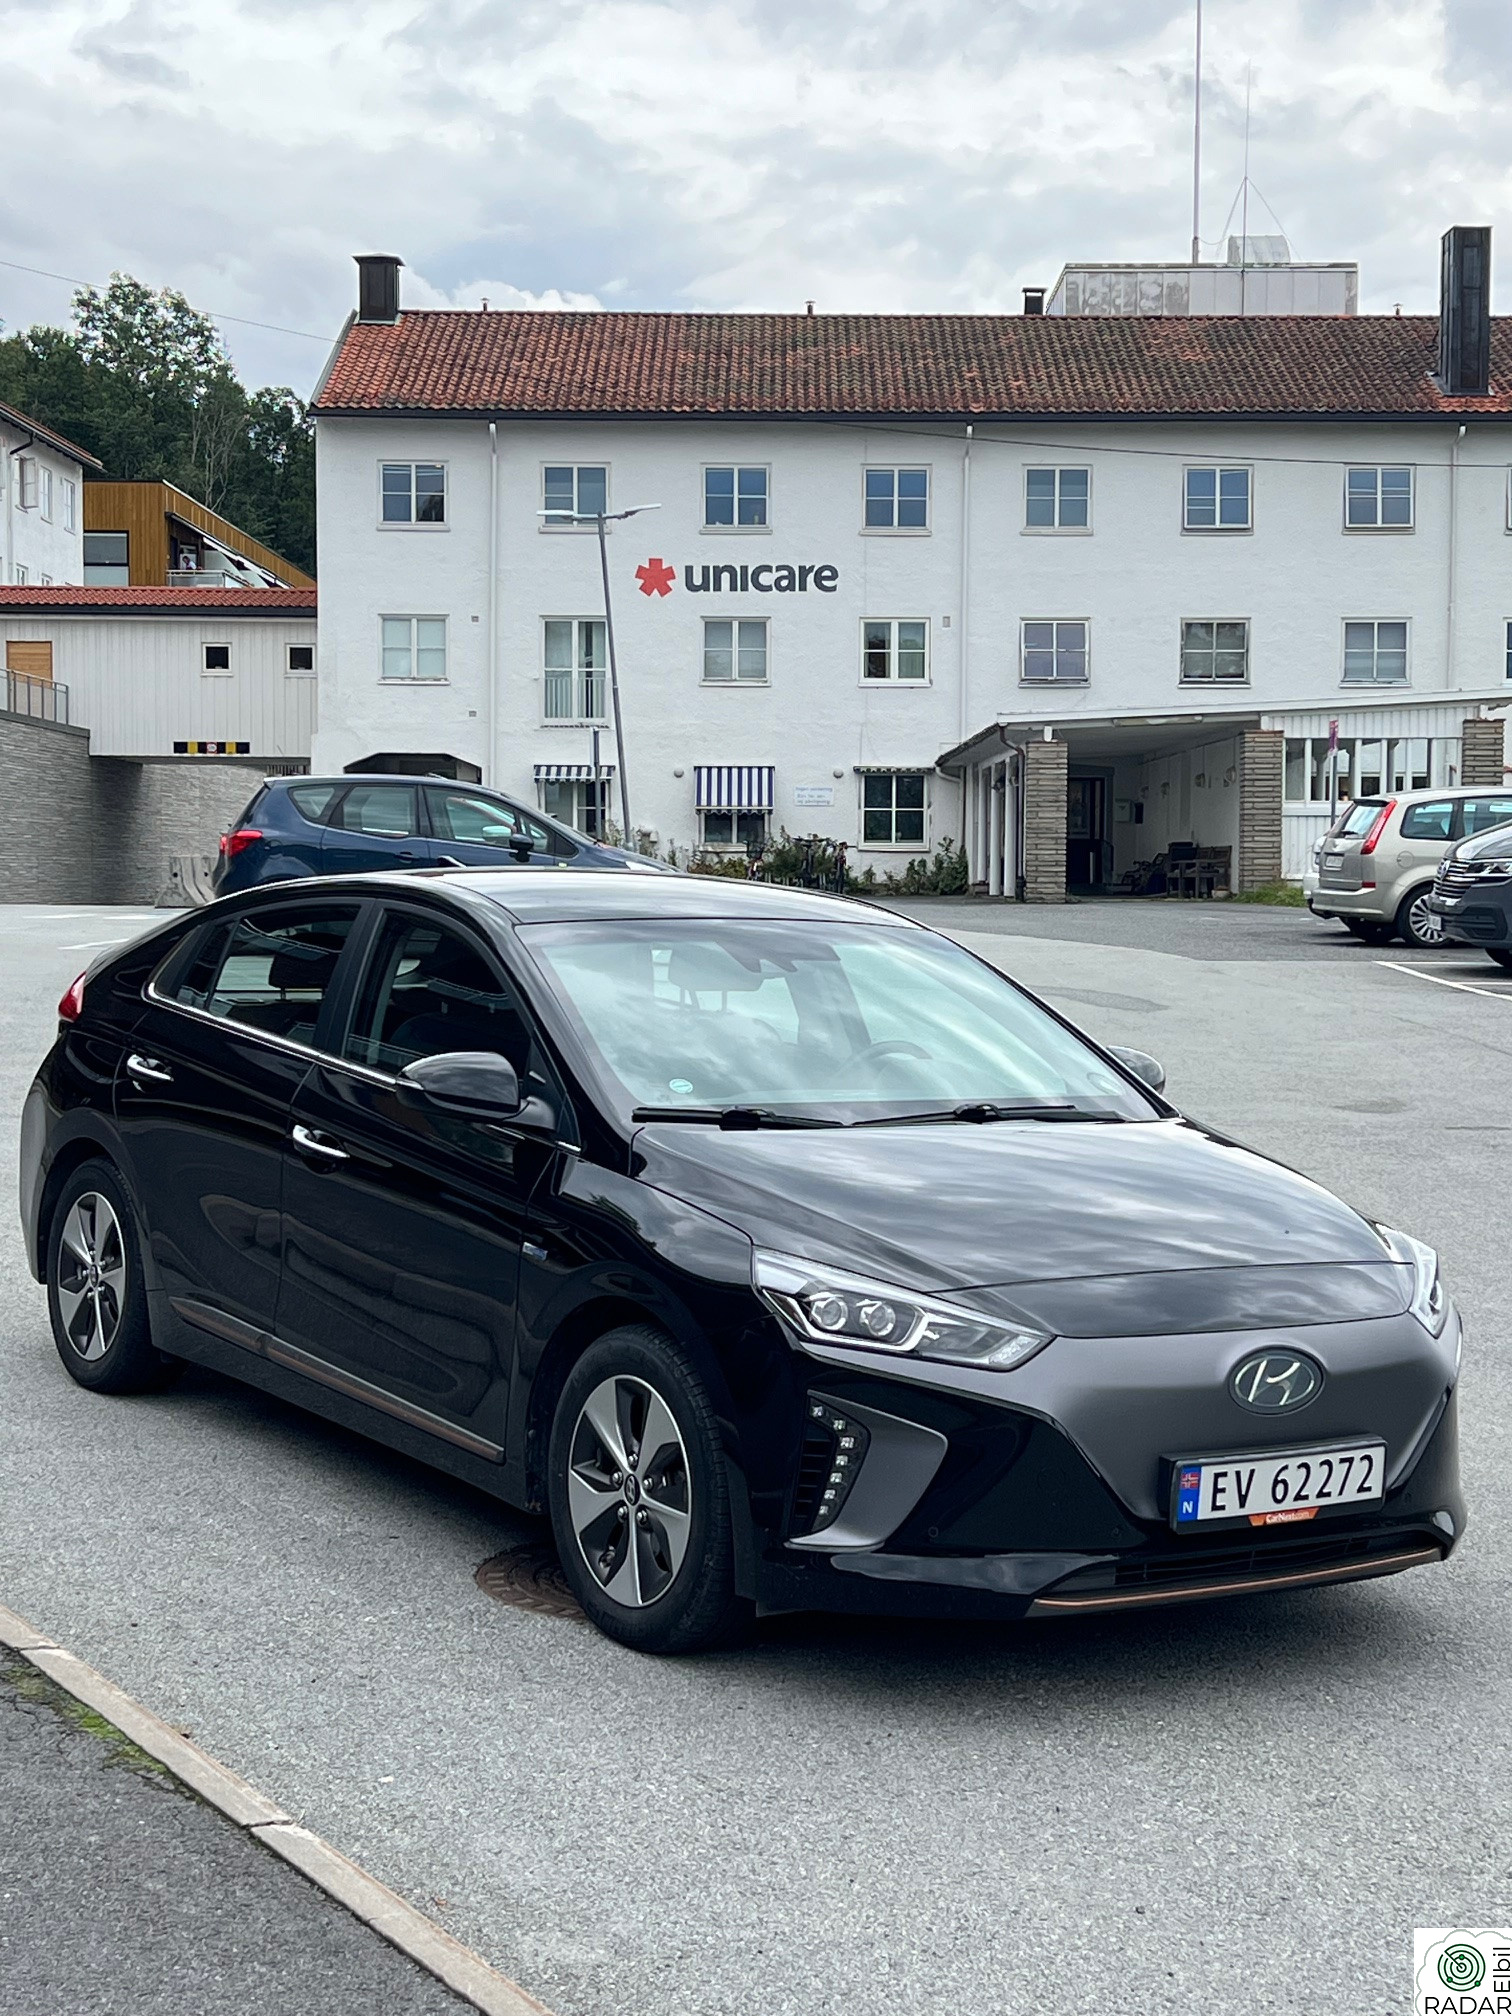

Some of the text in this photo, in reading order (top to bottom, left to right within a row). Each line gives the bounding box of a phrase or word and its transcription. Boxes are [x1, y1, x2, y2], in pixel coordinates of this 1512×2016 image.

[684, 564, 839, 593] unicare
[1210, 1453, 1374, 1512] EV 62272
[1182, 1500, 1194, 1514] N
